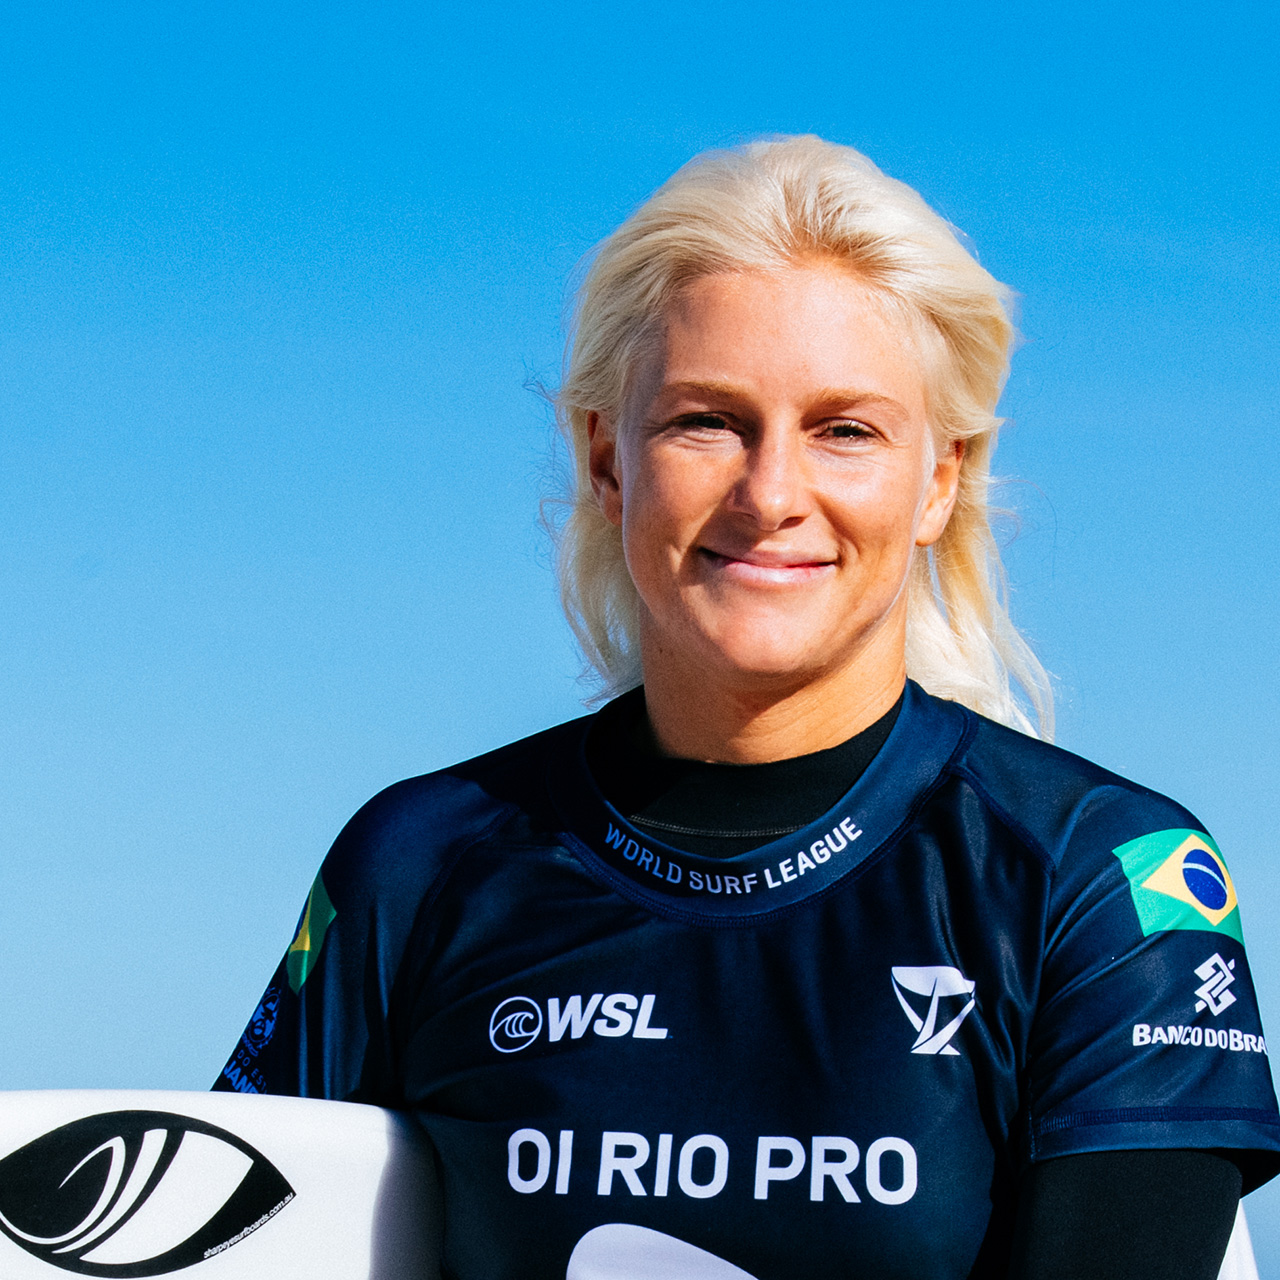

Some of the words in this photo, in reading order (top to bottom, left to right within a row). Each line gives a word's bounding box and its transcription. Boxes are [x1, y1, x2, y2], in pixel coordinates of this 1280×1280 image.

[604, 822, 682, 884] WORLD
[689, 870, 758, 894] SURF
[764, 816, 863, 889] LEAGUE
[547, 993, 669, 1042] WSL
[507, 1128, 574, 1195] OI
[597, 1131, 730, 1199] RIO
[754, 1136, 918, 1206] PRO
